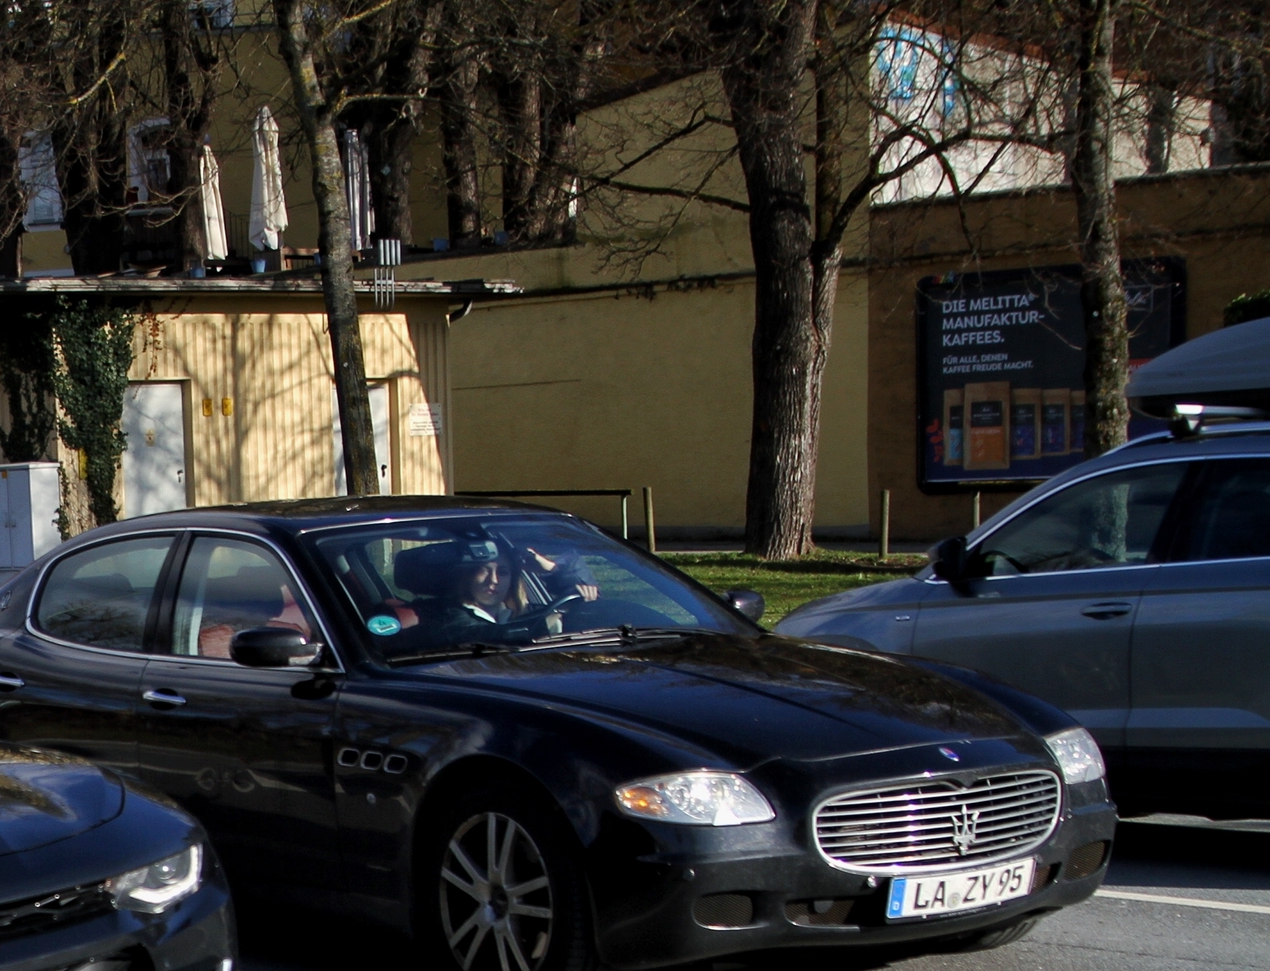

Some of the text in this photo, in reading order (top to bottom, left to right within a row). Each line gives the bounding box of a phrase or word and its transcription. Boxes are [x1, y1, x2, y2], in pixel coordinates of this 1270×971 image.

[942, 299, 966, 314] DIE
[942, 309, 1045, 330] MANUFAKTUR-
[942, 330, 1005, 347] KAFFEES.
[942, 353, 1008, 365] FÜR ALLE, DENEN
[942, 360, 1034, 374] KAFFEE FREUDE MACHT.
[913, 881, 946, 911] LA
[962, 873, 996, 903] ZY
[998, 866, 1024, 896] 95
